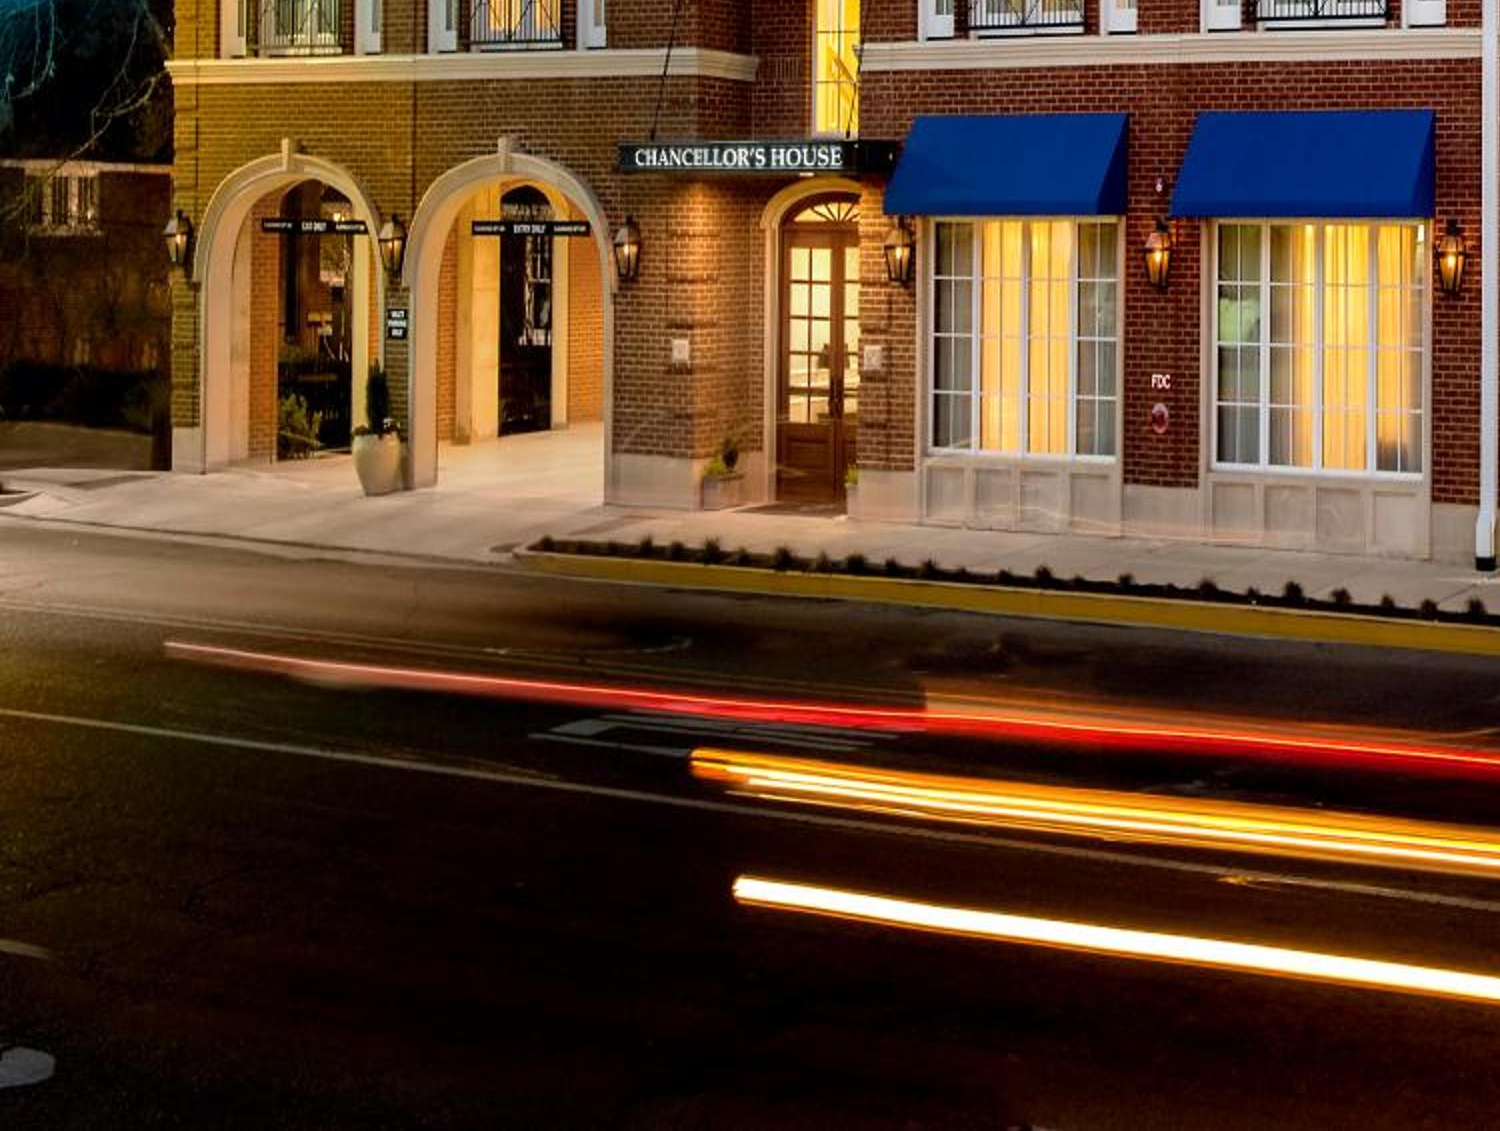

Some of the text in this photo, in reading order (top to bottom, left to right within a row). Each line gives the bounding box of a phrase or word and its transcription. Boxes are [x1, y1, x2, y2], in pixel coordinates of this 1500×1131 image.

[634, 145, 844, 167] CHANCELLOR'S HOUSE
[1151, 373, 1171, 389] FDC
